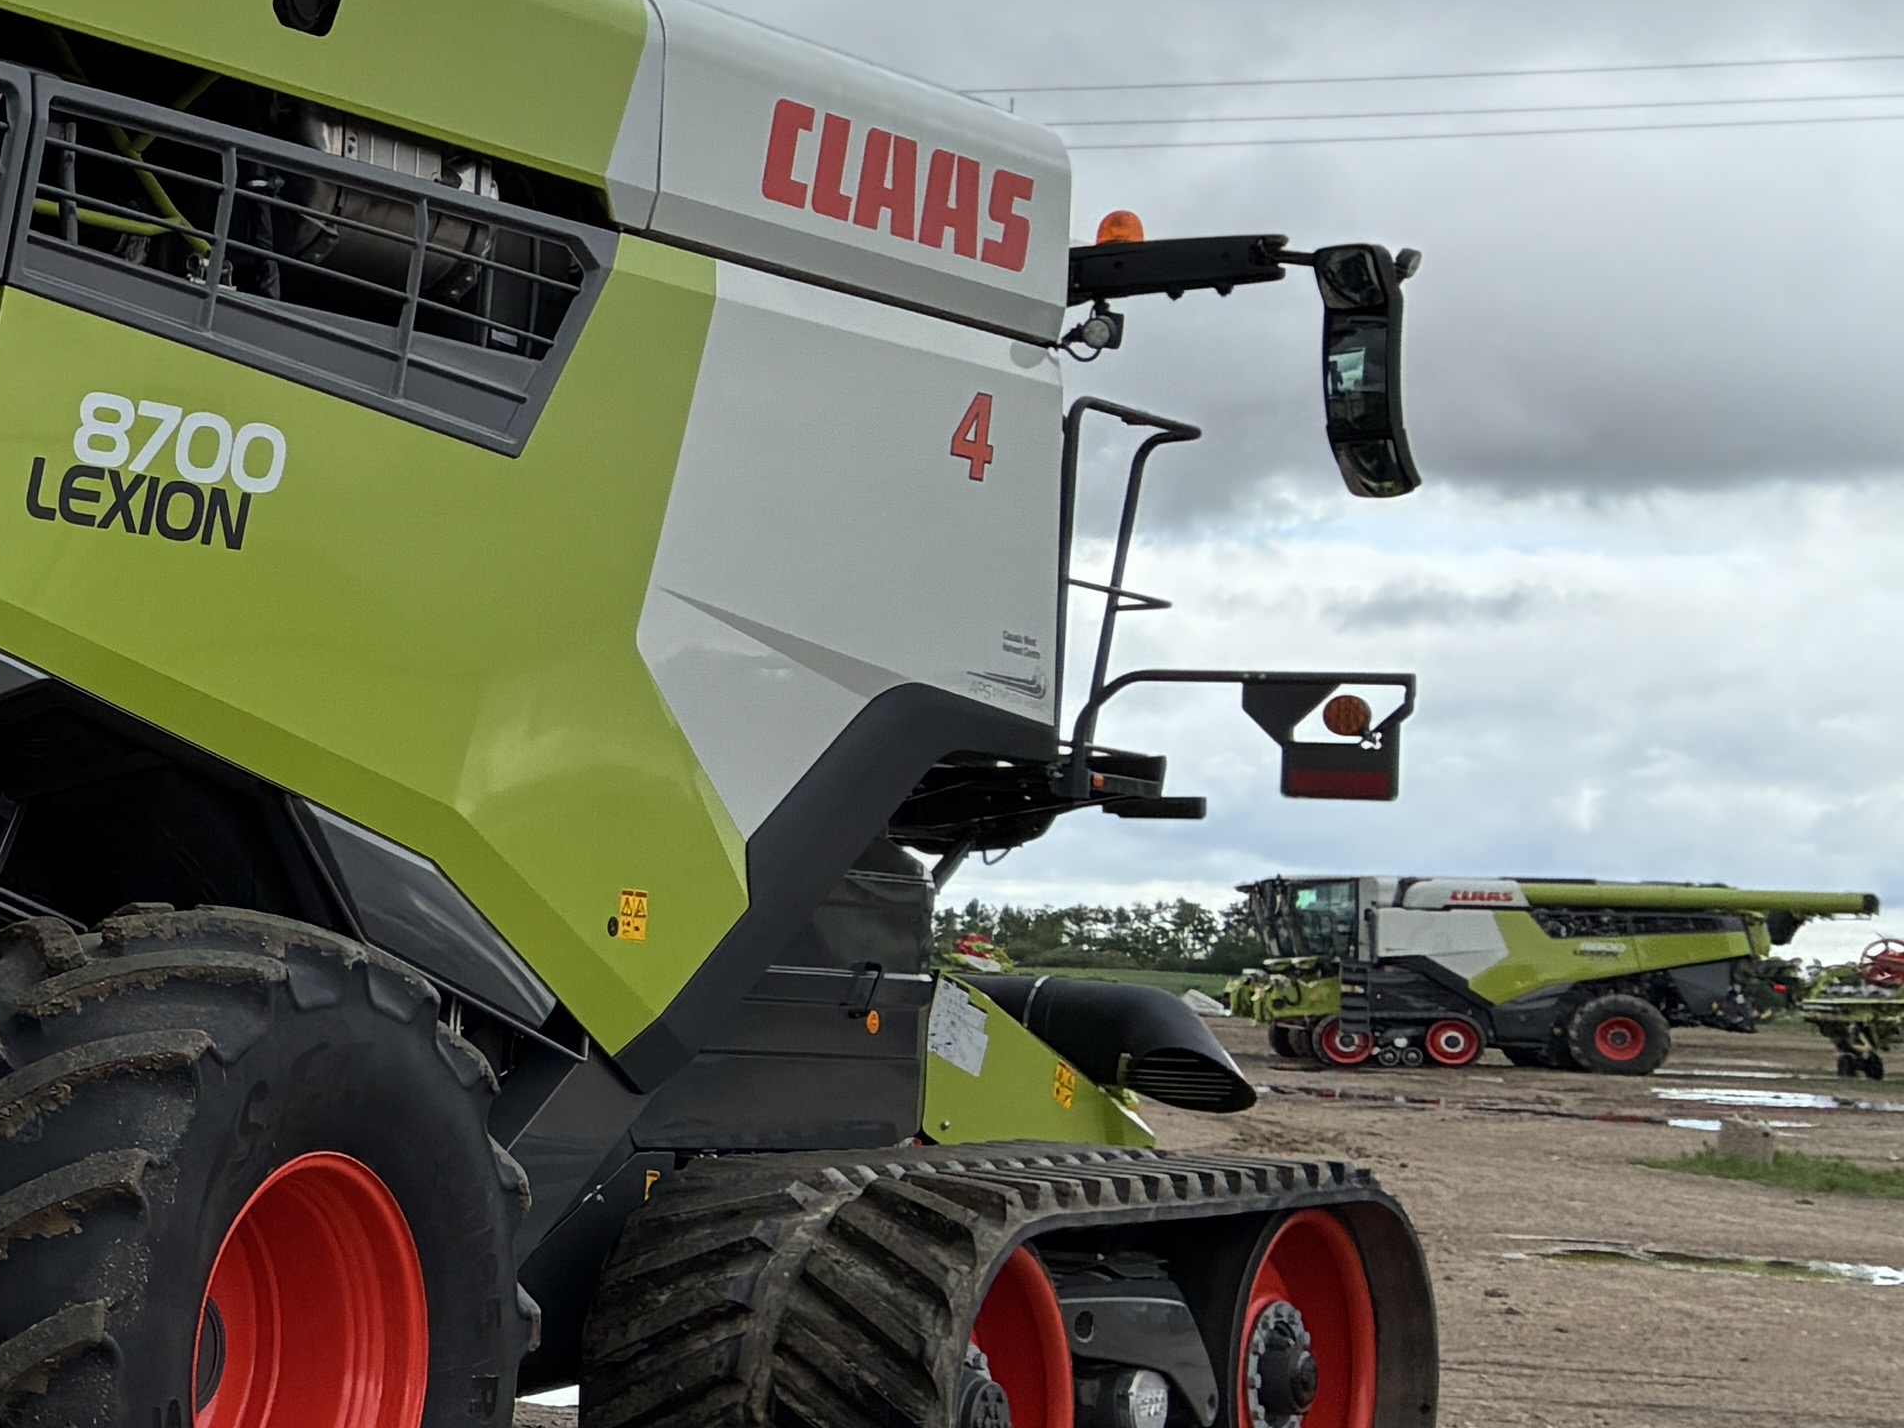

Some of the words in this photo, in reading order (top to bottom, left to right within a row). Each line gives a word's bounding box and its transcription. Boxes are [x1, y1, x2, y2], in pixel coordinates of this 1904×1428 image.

[761, 98, 1035, 273] CLAAS
[71, 390, 288, 495] 8700
[949, 391, 995, 482] 4
[26, 455, 255, 551] LEXION
